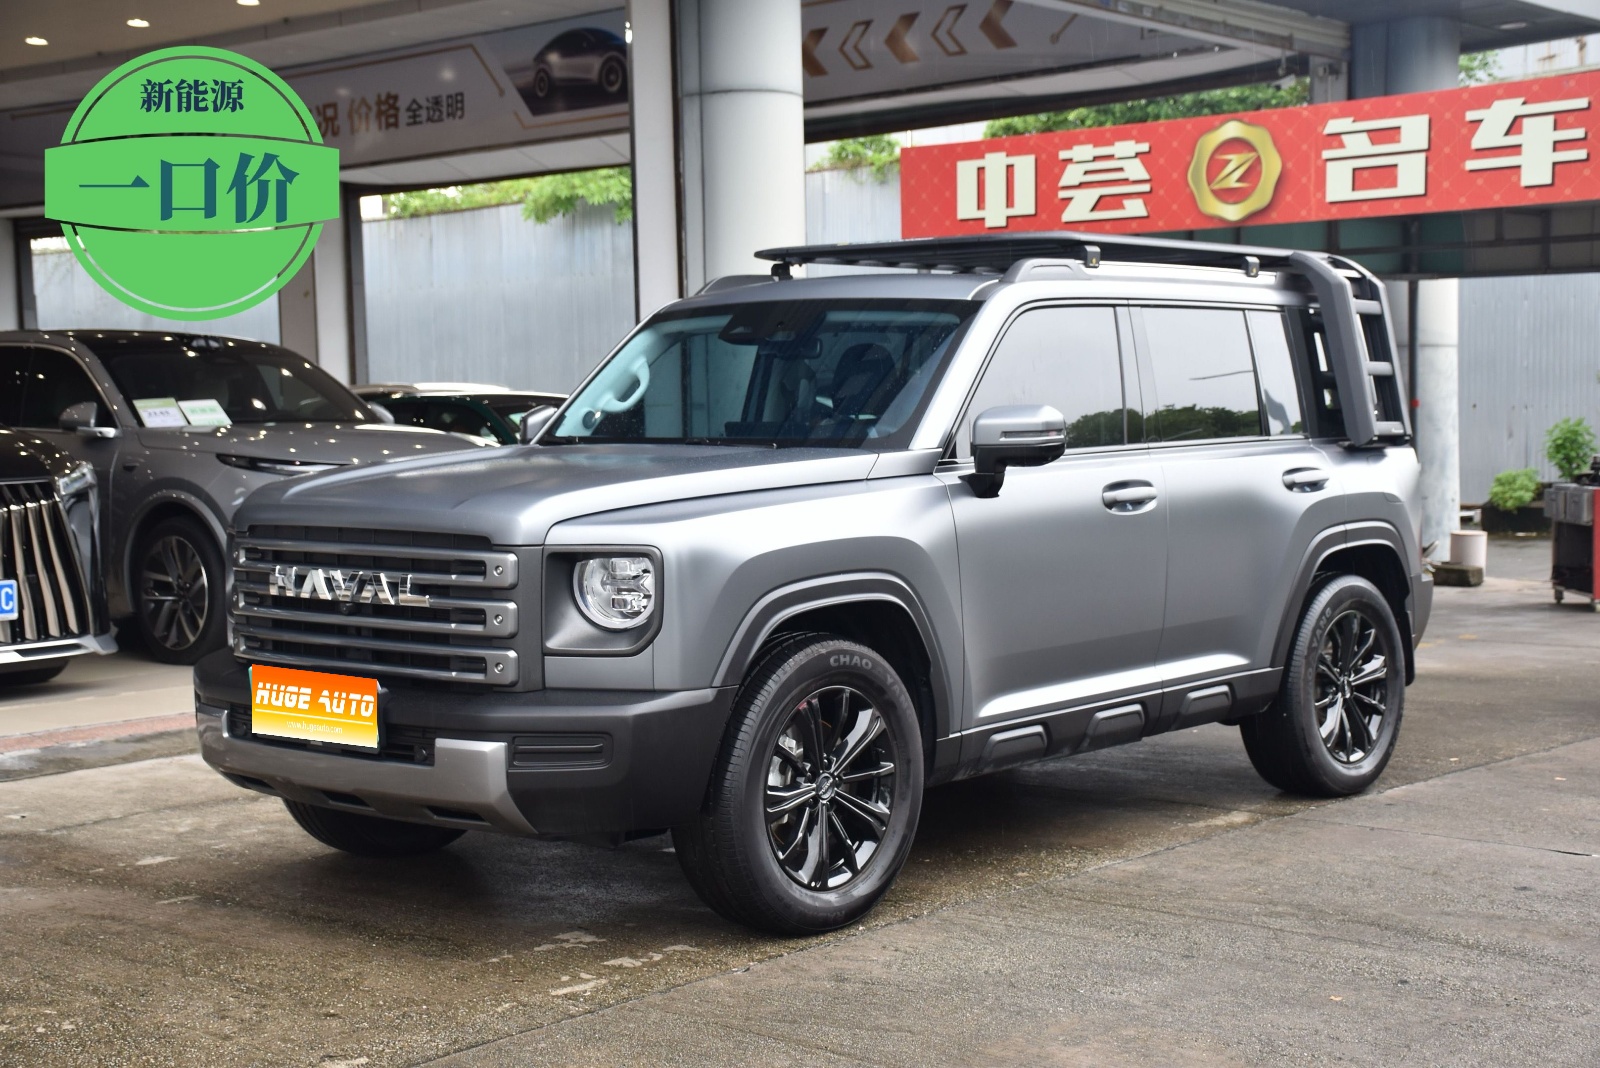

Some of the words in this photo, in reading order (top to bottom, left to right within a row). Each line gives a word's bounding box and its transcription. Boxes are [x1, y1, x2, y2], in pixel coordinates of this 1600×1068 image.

[309, 102, 340, 137] 况
[349, 91, 400, 134] 价格
[405, 92, 465, 127] 全透明
[956, 140, 1152, 228] 中荟
[1321, 97, 1590, 203] 名车
[269, 565, 430, 607] HAVAL
[829, 654, 873, 670] CHAO
